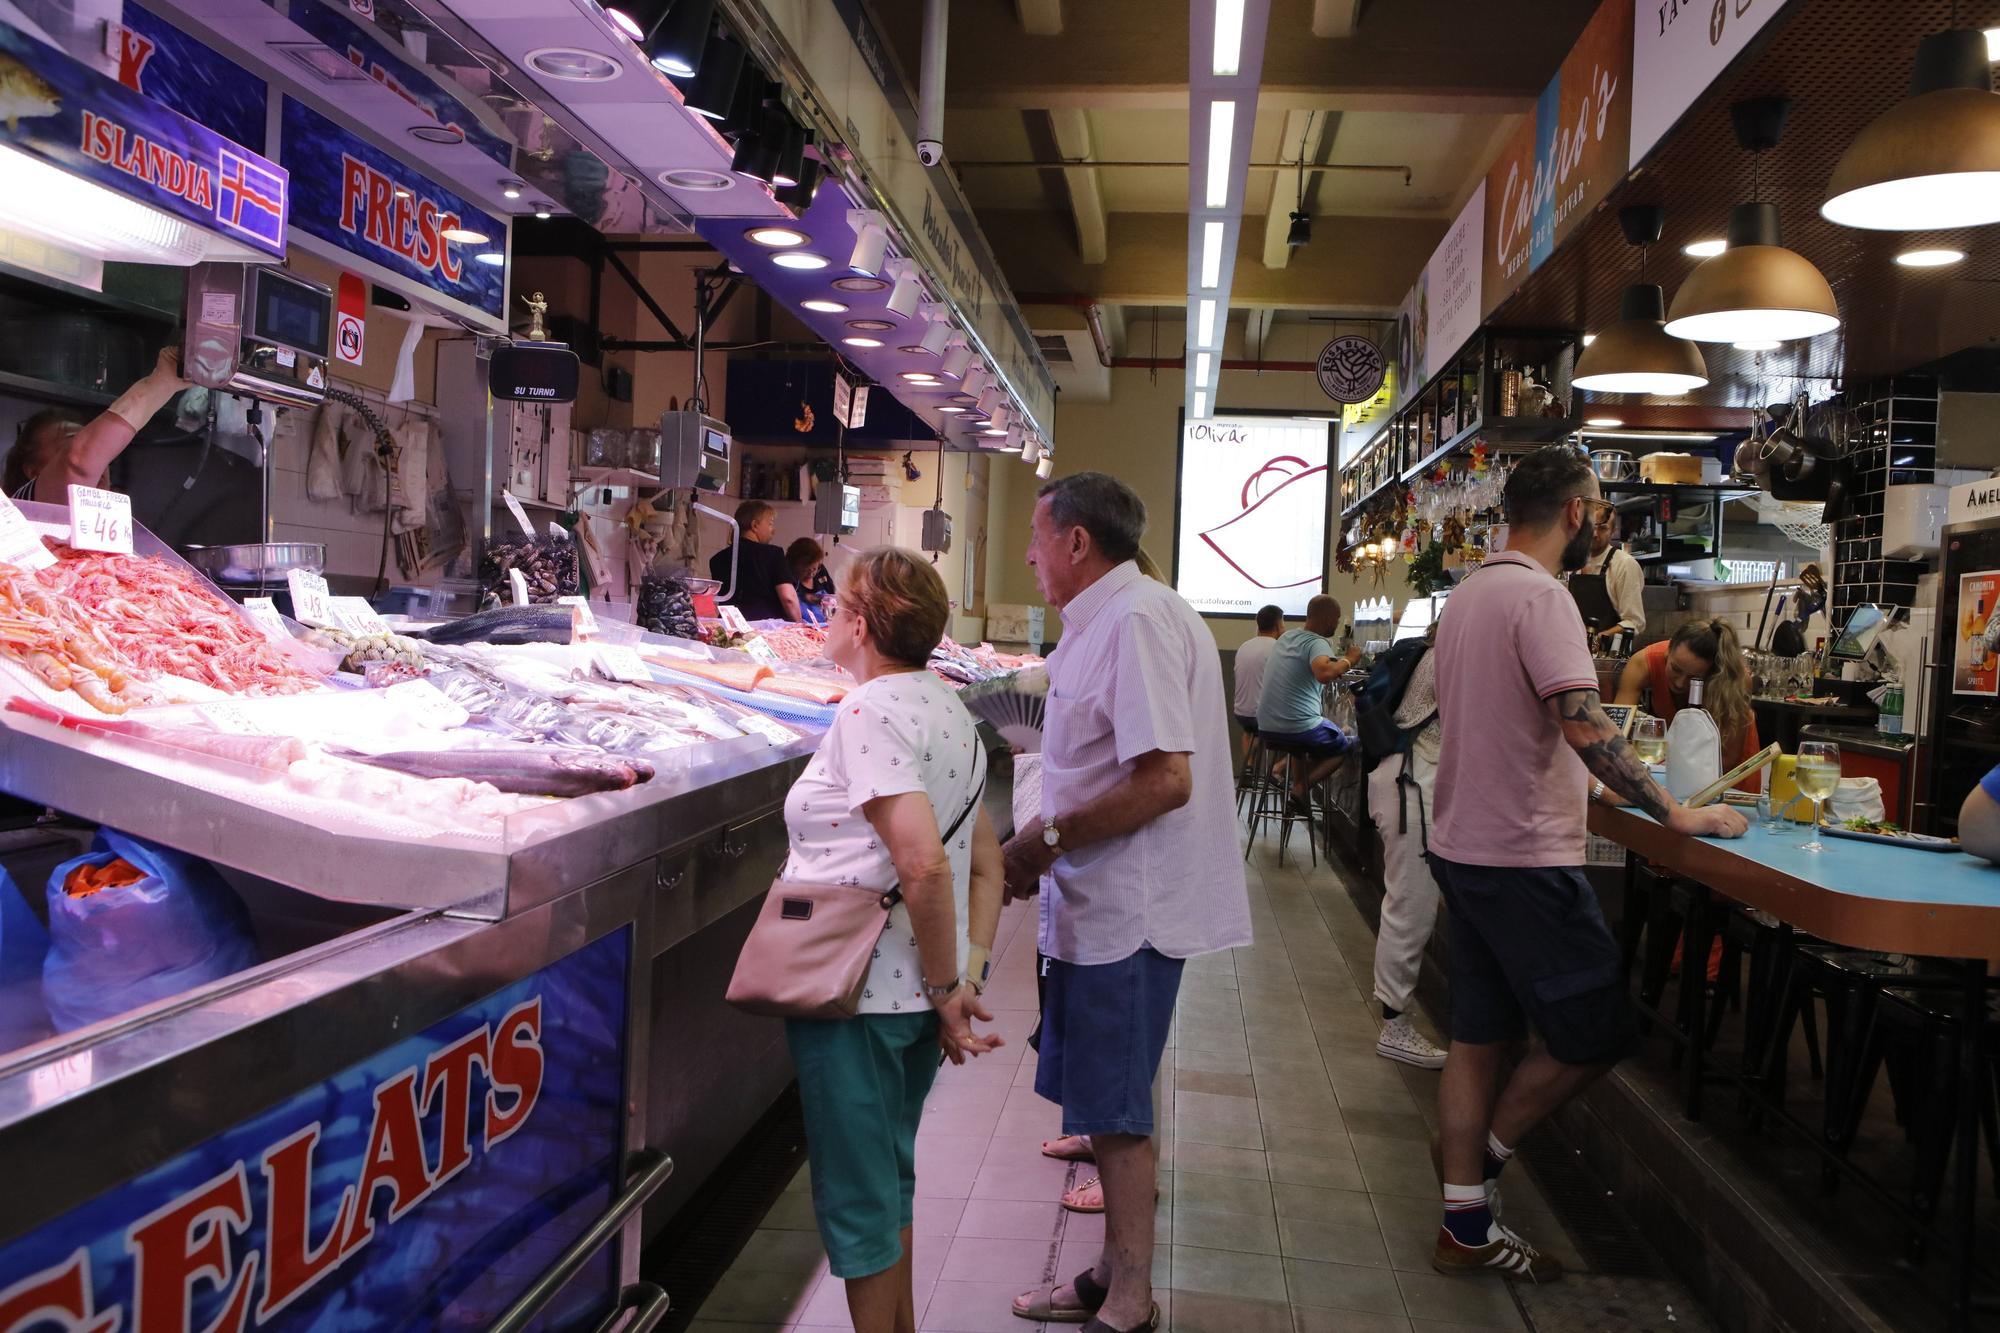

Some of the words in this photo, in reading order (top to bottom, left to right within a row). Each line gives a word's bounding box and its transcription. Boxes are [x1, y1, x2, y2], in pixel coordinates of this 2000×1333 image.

[81, 110, 212, 210] ISLANDIA
[1498, 64, 1617, 265] Castro's
[340, 152, 462, 284] FRESC
[1322, 345, 1342, 372] ROSA
[514, 387, 526, 395] SU
[529, 387, 555, 396] TURNO
[94, 512, 118, 542] 46
[310, 594, 323, 619] 18
